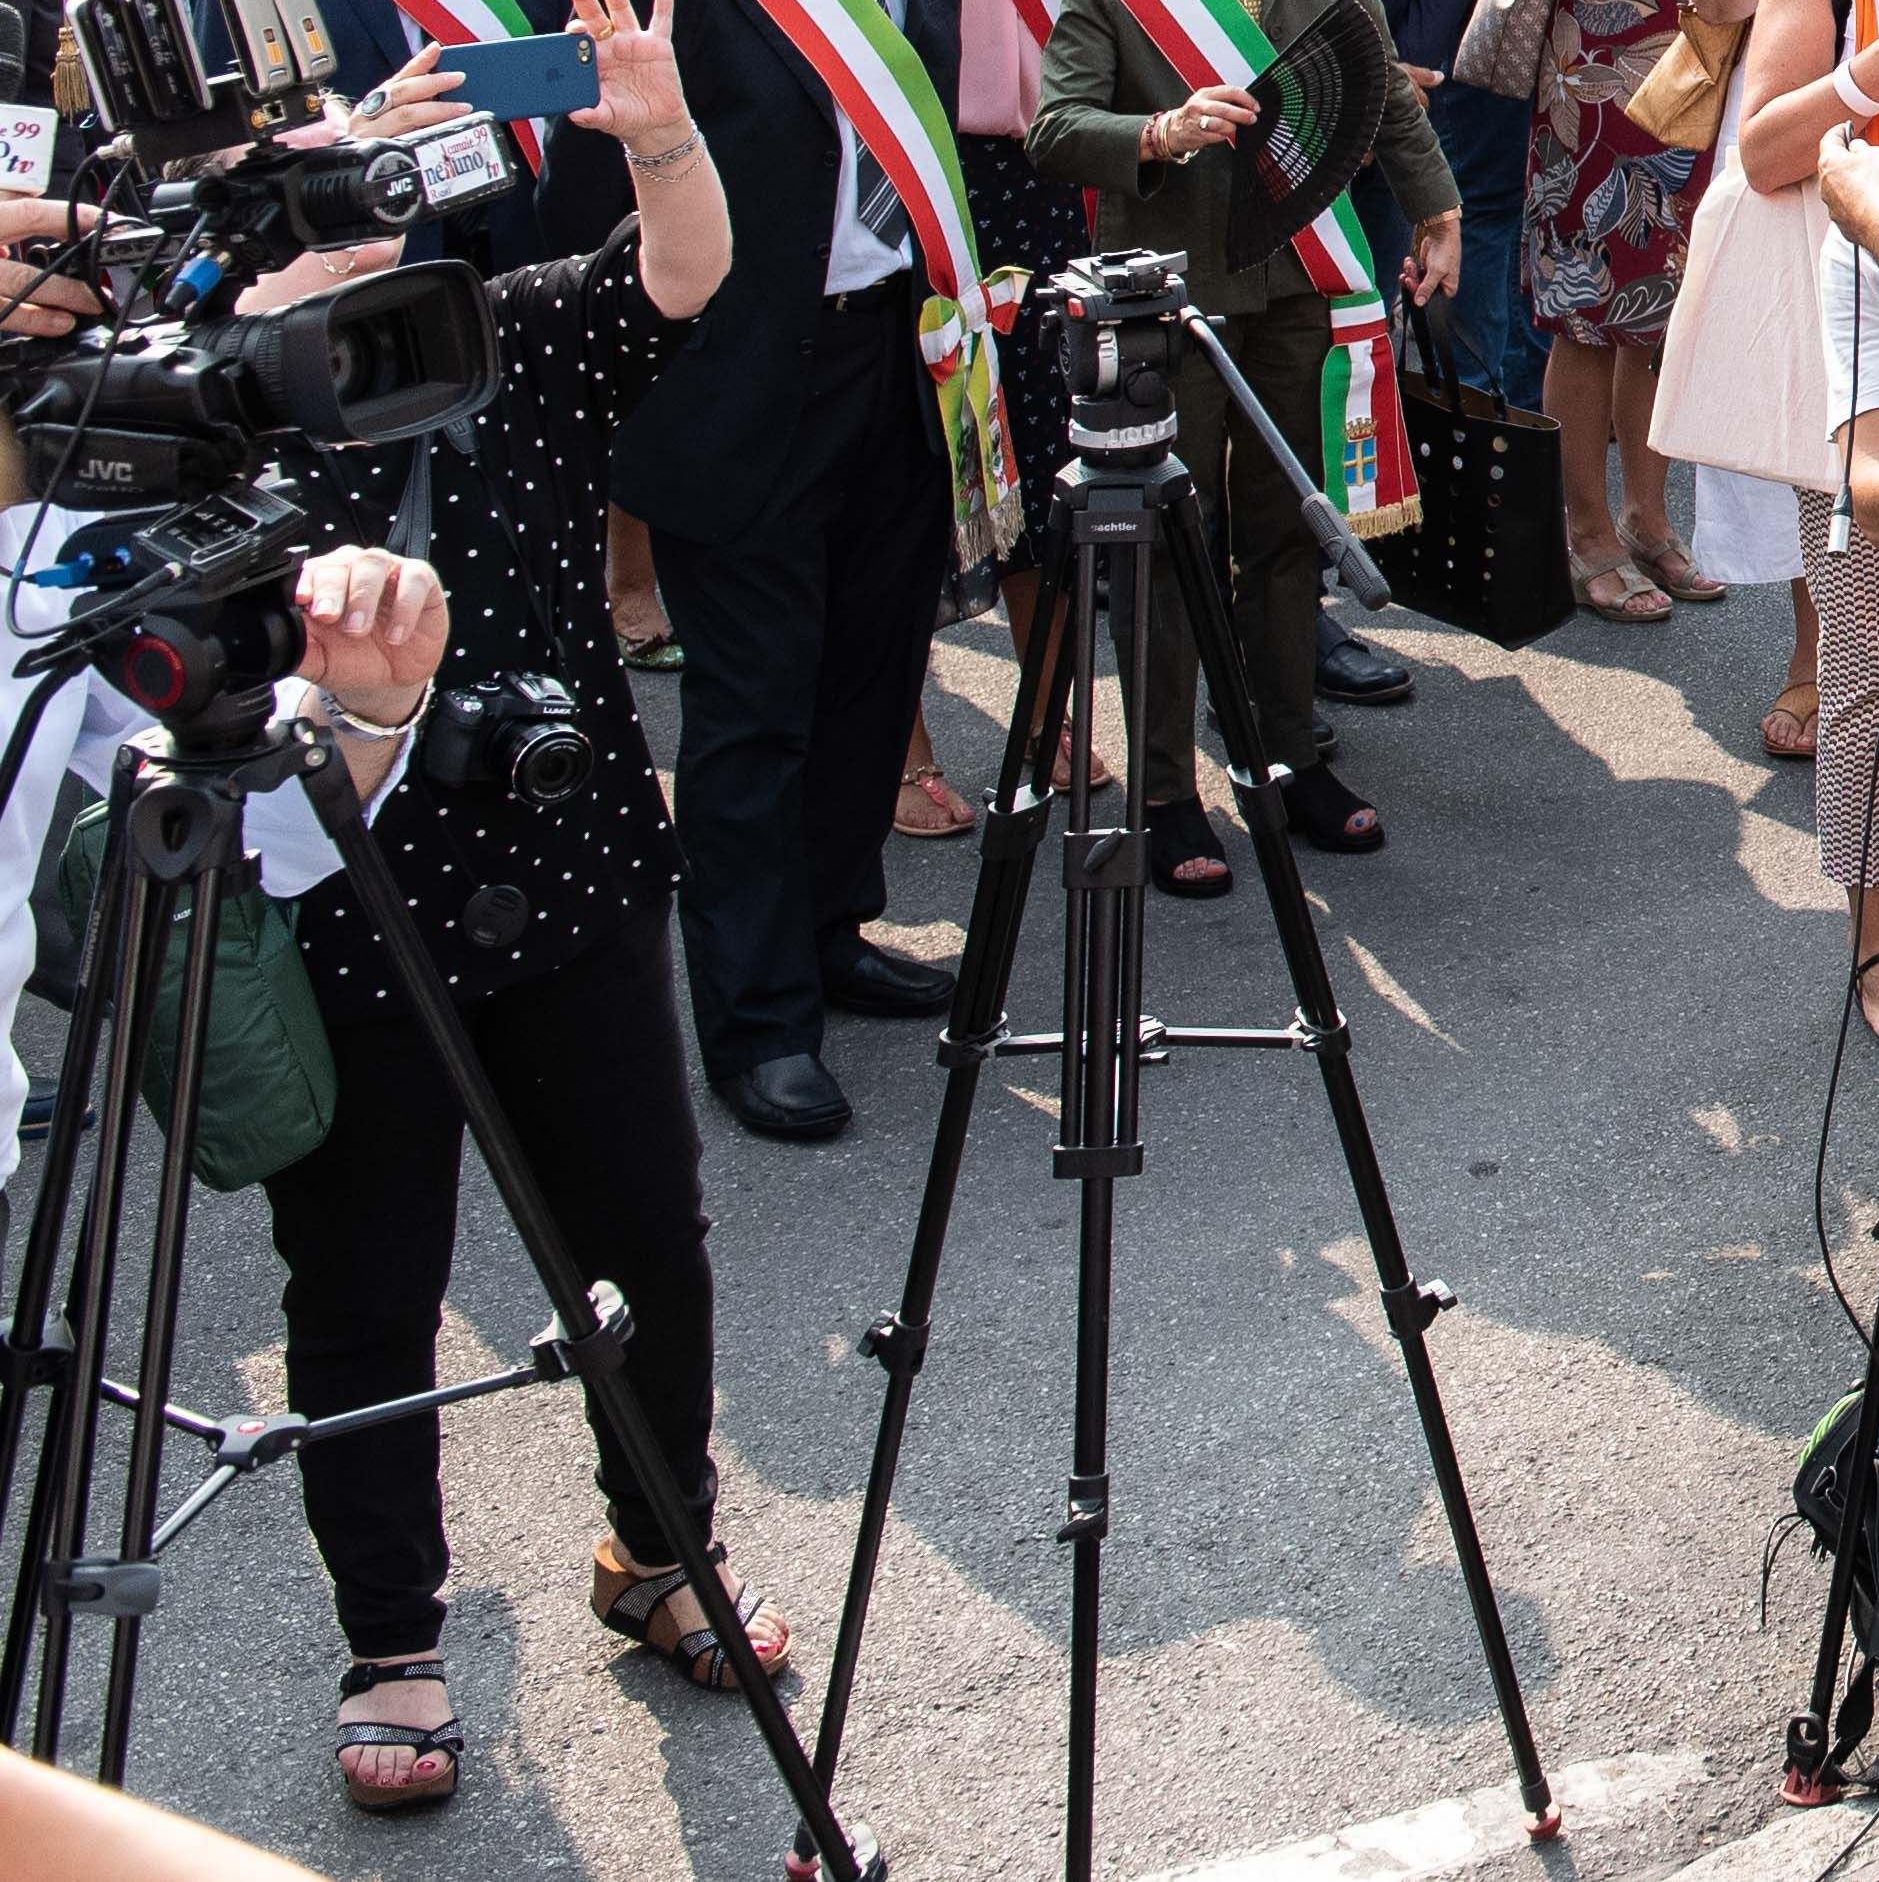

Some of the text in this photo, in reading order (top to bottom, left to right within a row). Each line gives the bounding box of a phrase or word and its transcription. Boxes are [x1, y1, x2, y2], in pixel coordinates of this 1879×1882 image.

[12, 121, 41, 140] 99
[473, 126, 489, 146] 99
[7, 155, 35, 175] tv
[485, 160, 501, 180] tv
[387, 178, 414, 196] JVC
[79, 459, 132, 482] JVC
[543, 706, 573, 715] LUMIX
